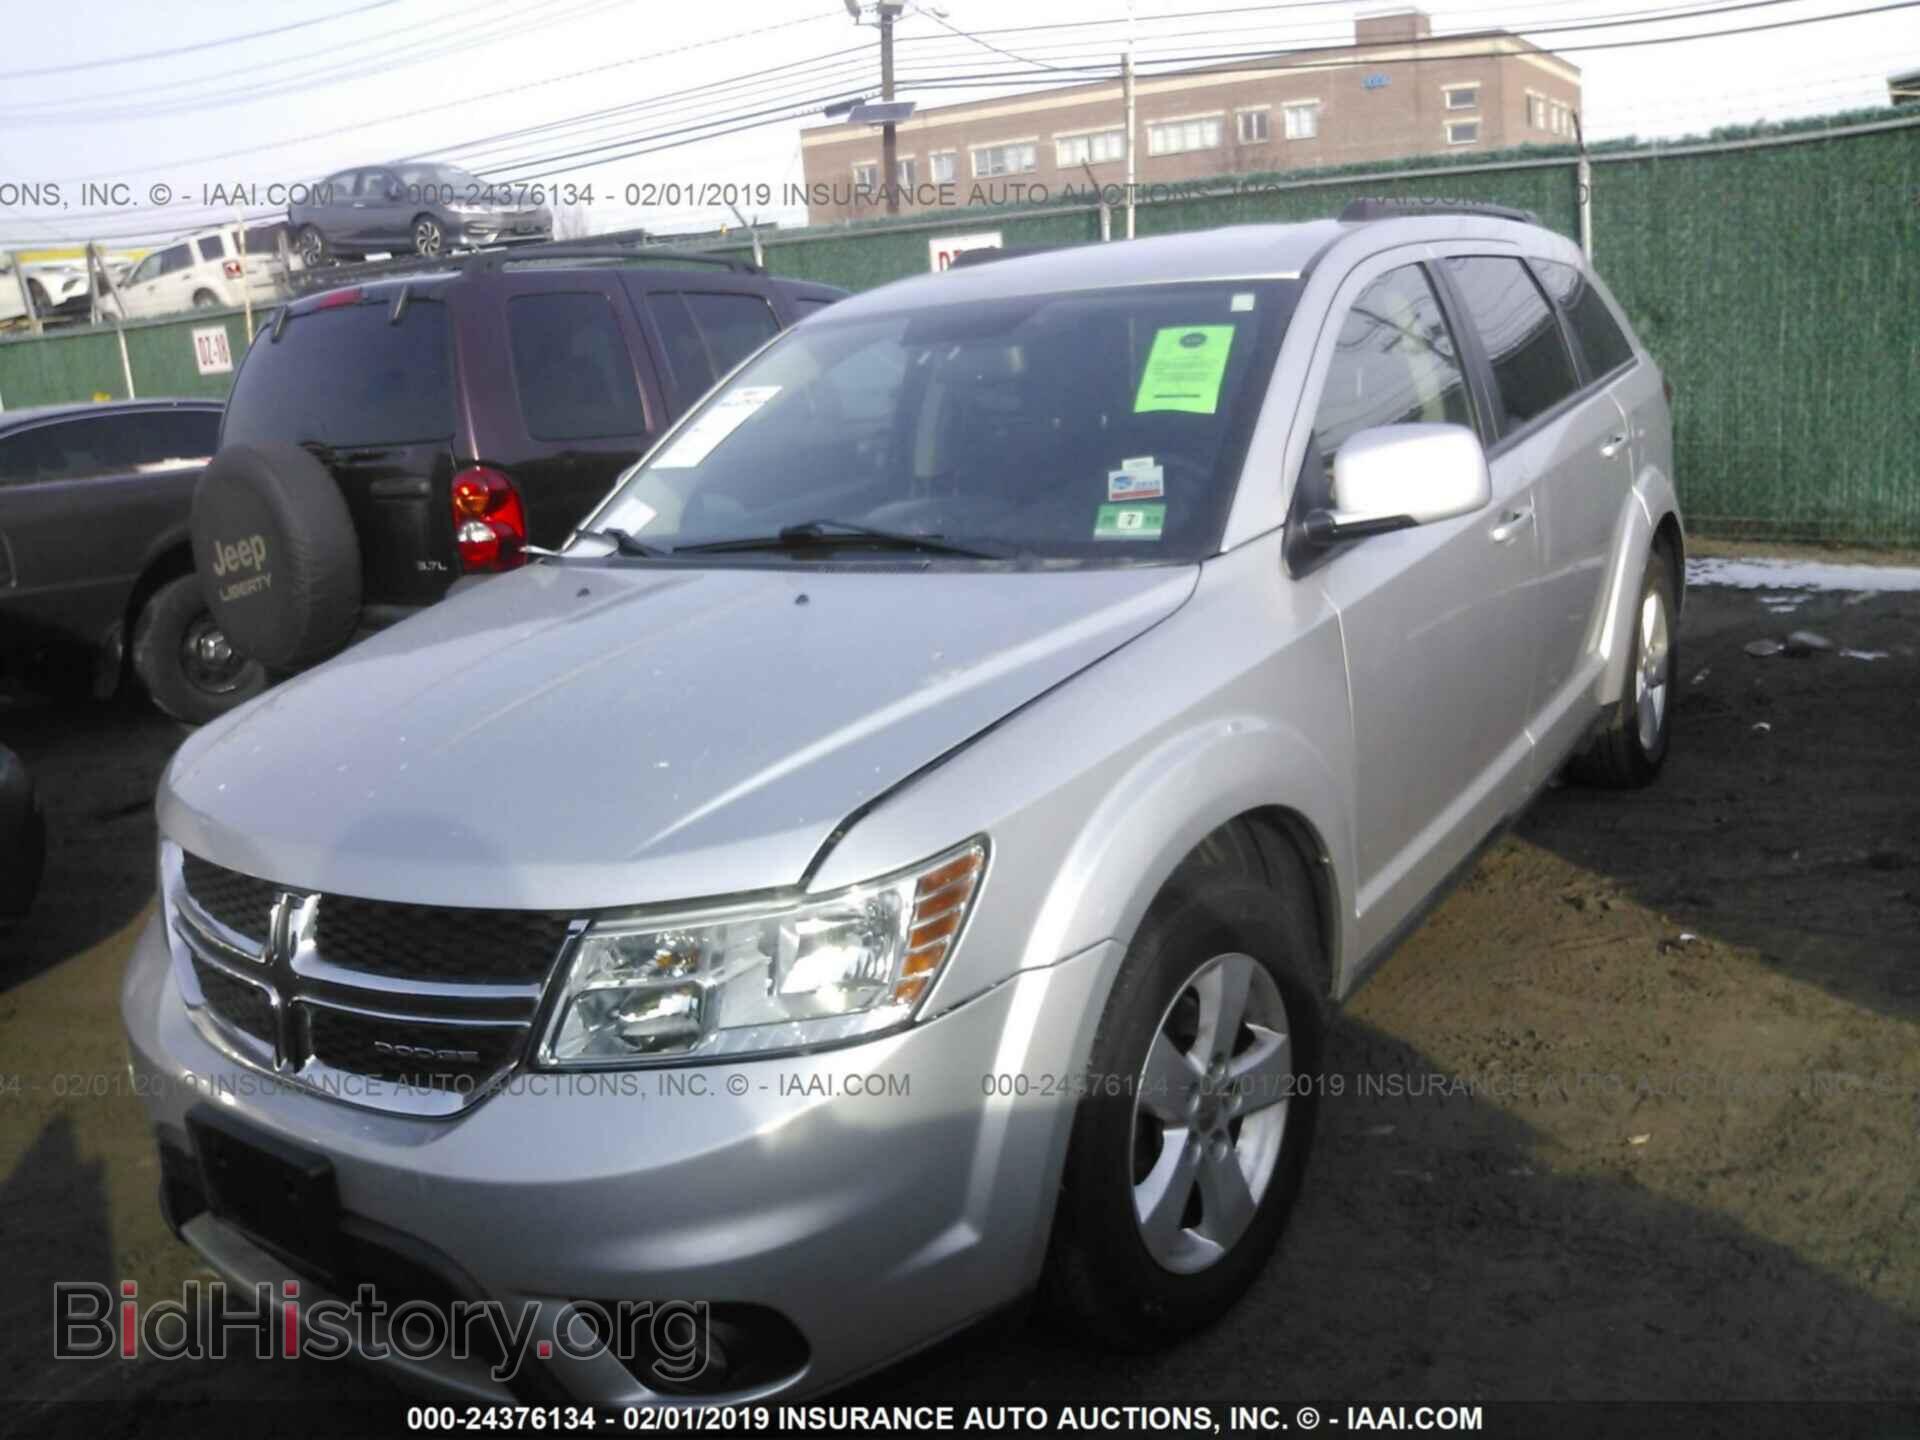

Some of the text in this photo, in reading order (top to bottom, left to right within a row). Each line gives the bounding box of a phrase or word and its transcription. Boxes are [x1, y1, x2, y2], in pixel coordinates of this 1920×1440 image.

[212, 534, 267, 576] Jeep
[218, 572, 272, 602] LIBERTY
[373, 1040, 480, 1063] DODGE
